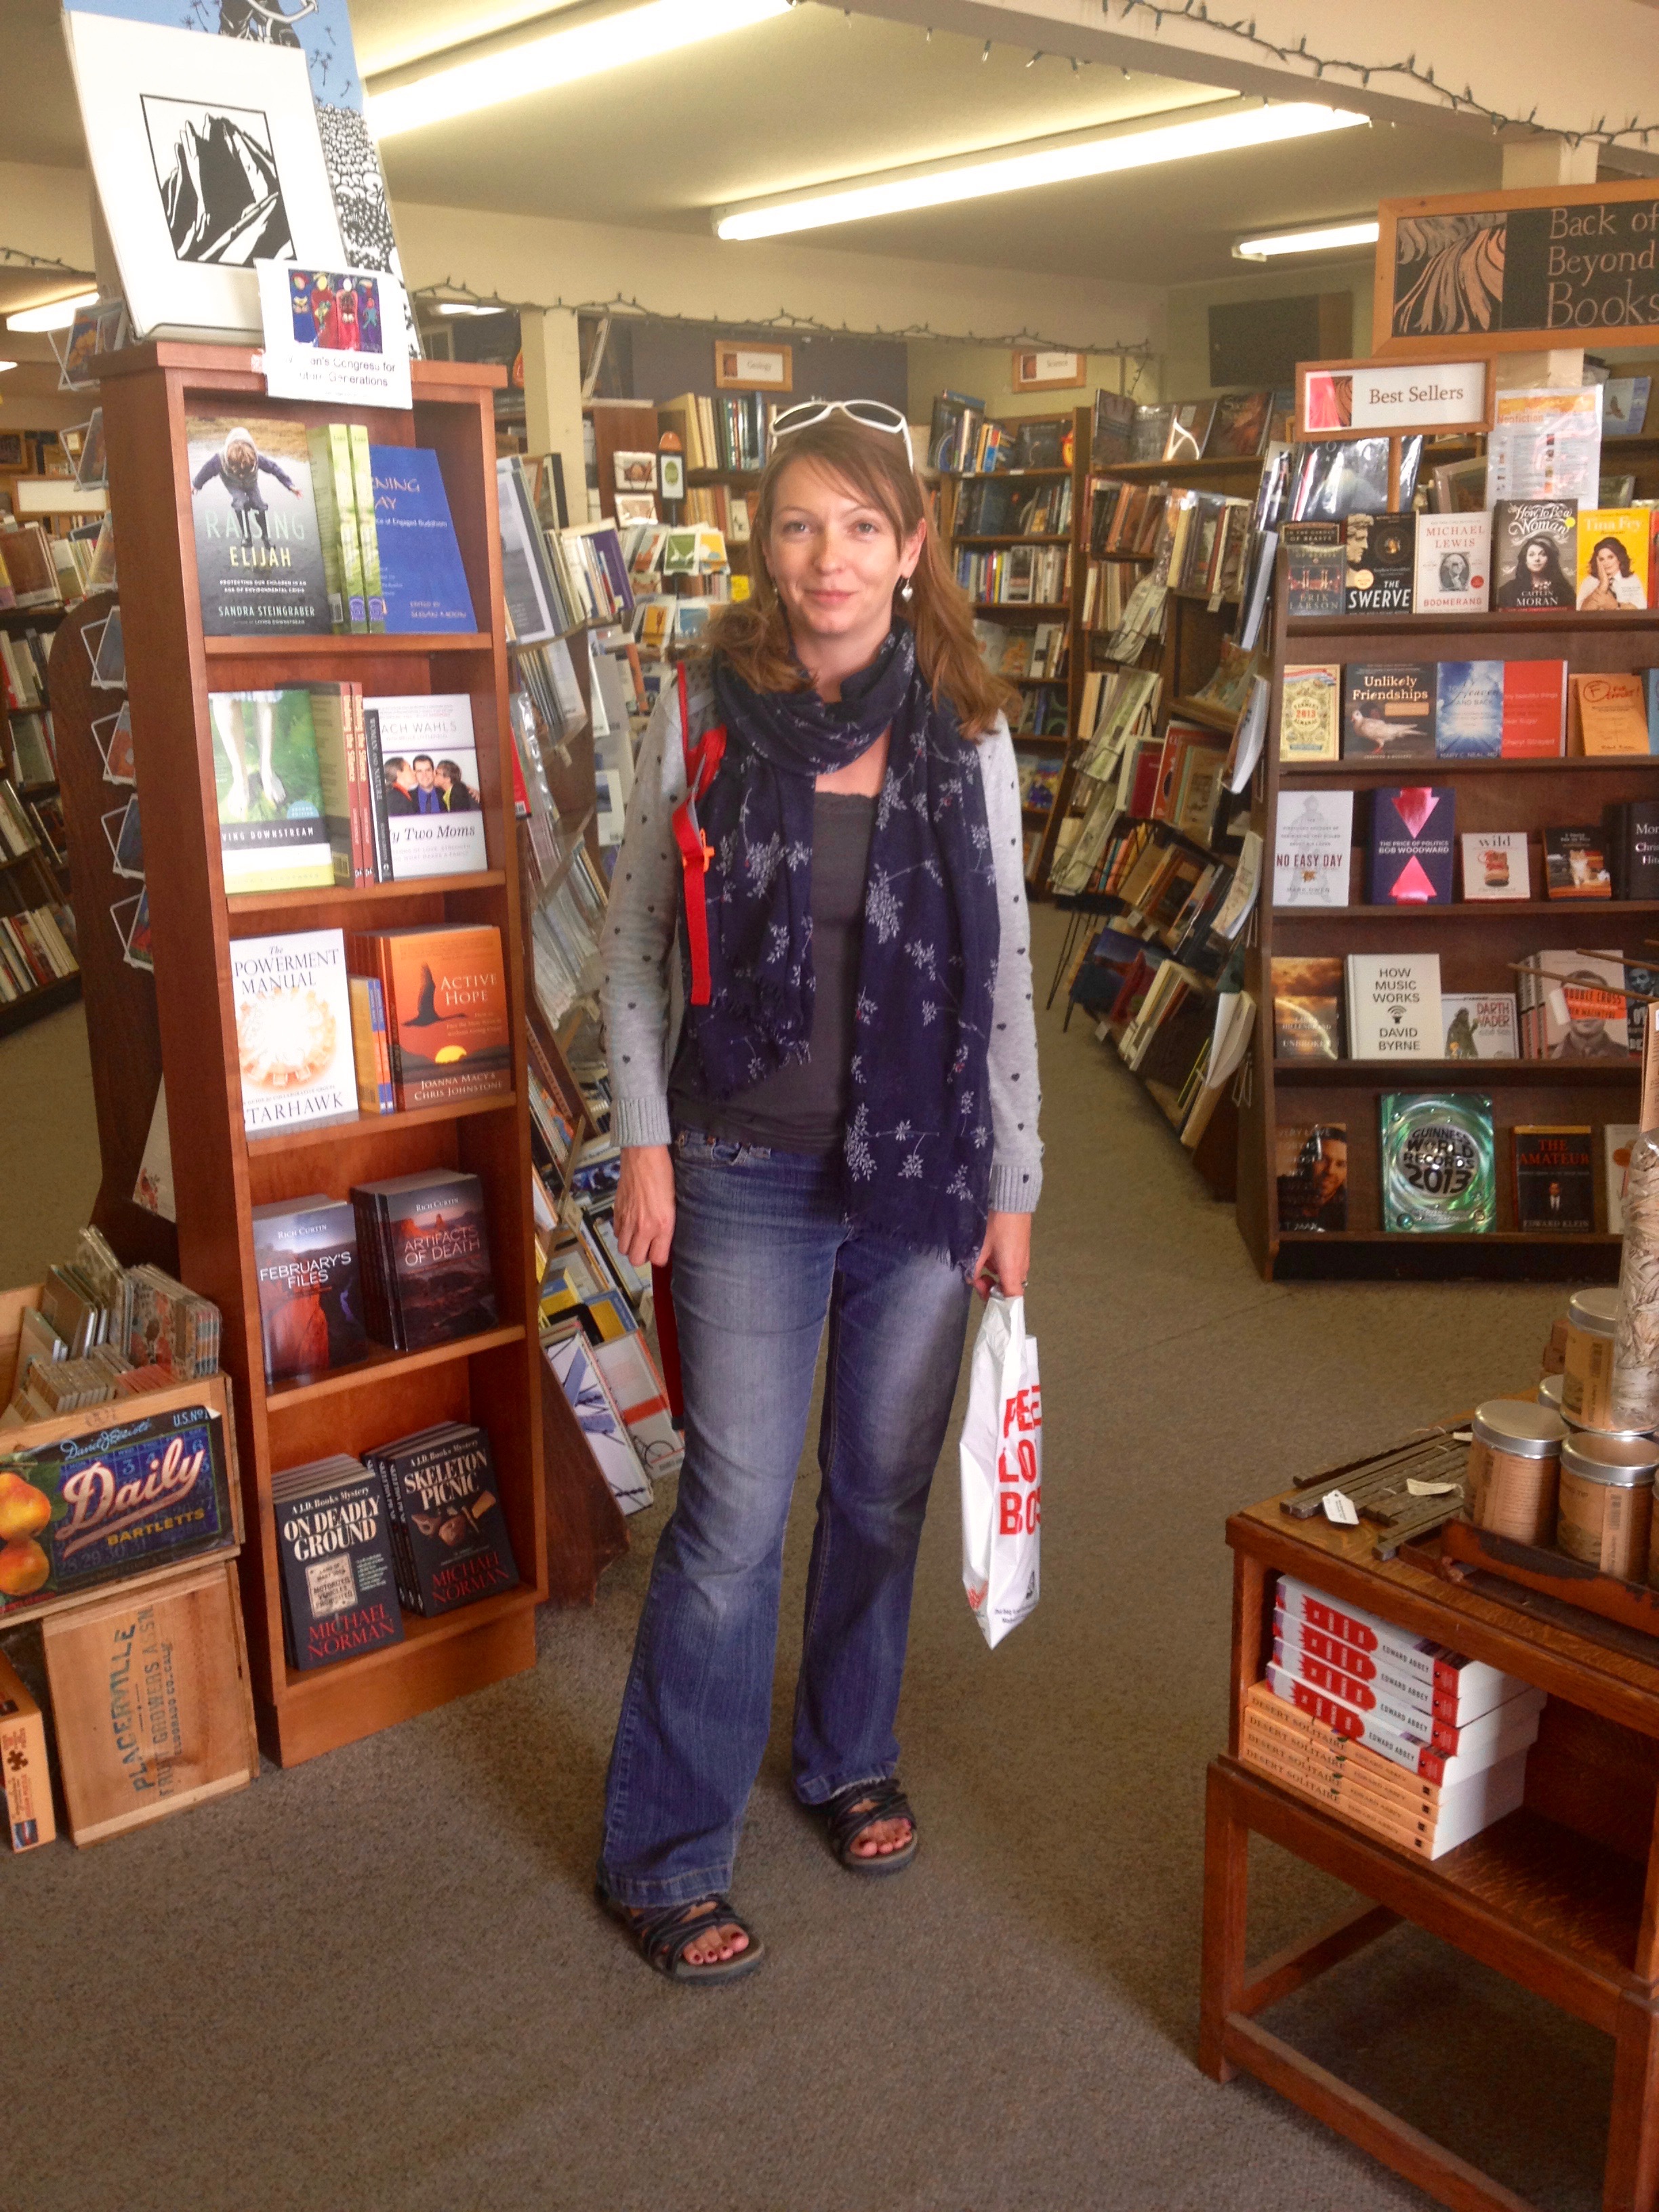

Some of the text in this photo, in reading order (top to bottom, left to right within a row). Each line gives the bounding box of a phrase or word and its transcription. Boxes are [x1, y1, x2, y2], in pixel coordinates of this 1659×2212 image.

[1549, 201, 1659, 239] Back of
[1547, 239, 1655, 287] Beyond
[1547, 279, 1659, 329] Books
[383, 361, 396, 372] for
[329, 371, 388, 387] Generations
[1369, 384, 1464, 404] Best Sellers
[205, 509, 305, 540] RAISING
[1427, 526, 1485, 537] MICHAEL
[1509, 518, 1570, 535] Woman
[1583, 516, 1642, 532] Tina Fey
[1435, 538, 1475, 548] LEWIS
[230, 545, 291, 568] ELIJAH
[1383, 579, 1400, 588] THE
[1290, 602, 1338, 610] LARSON
[1348, 588, 1411, 609] SWERVE
[1424, 597, 1483, 607] BOOMERANG
[1516, 597, 1559, 607] MORAN
[218, 605, 316, 617] SANDRA STEINGRABER
[1364, 675, 1417, 688] Unlikely
[1352, 689, 1428, 701] Friendships
[382, 720, 457, 734] ACH WAHLS
[222, 826, 314, 842] VING DOWNSTREAM
[404, 825, 475, 840] Two Moms
[1479, 835, 1511, 847] wild
[1277, 854, 1343, 867] NO EASY DAY
[270, 945, 284, 956] The
[234, 948, 340, 977] POWERMENT
[441, 973, 497, 991] ACTIVE
[1379, 968, 1412, 978] HOW
[241, 975, 316, 995] MANUAL
[1375, 981, 1416, 991] MUSIC
[445, 989, 488, 1006] HOPE
[1373, 993, 1420, 1003] WORKS
[1477, 1002, 1510, 1015] DARTH
[1478, 1017, 1510, 1028] VADER
[1379, 1027, 1418, 1038] DAVID
[1378, 1041, 1420, 1051] BYRNE
[421, 1073, 490, 1090] JOANNA MACY
[414, 1081, 503, 1101] CHRIS JOHNSTONE
[244, 1092, 344, 1124] TARHAWK
[1412, 1126, 1471, 1145] GUINNESS
[1406, 1141, 1474, 1158] WORLD
[1538, 1139, 1567, 1152] THE
[1404, 1153, 1475, 1169] RECORDS
[1520, 1153, 1590, 1166] AMATEUR
[1404, 1163, 1472, 1194] 2013
[278, 1223, 327, 1240] RICH CURTIN
[405, 1225, 478, 1252] ARTIFACTS
[405, 1239, 480, 1267] OF DEATH
[260, 1251, 352, 1282] FEBRUARY'S
[288, 1269, 329, 1289] FILES
[404, 1448, 487, 1493] SKELETON
[55, 1437, 205, 1542] Daily
[421, 1473, 480, 1511] PICNIC
[291, 1505, 298, 1515] A
[314, 1496, 339, 1509] Books
[340, 1486, 369, 1503] Mystery
[107, 1507, 205, 1547] BARTLETTS
[283, 1495, 381, 1542] ON DEADLY
[294, 1517, 377, 1561] GROUND
[432, 1551, 500, 1588] MICHAEL
[432, 1565, 510, 1603] NORMAN
[308, 1603, 388, 1641] MICHAEL
[308, 1622, 394, 1660] NORMAN
[1382, 1645, 1429, 1674] EDWARD ABBEY
[1380, 1673, 1429, 1702] EDWARD ABBEY
[108, 1624, 156, 1793] PLACERVILLE
[143, 1660, 169, 1744] GROWERS
[1380, 1703, 1428, 1732] EDWARD ABBEY
[1368, 1732, 1415, 1761] EDWARD ABBEY
